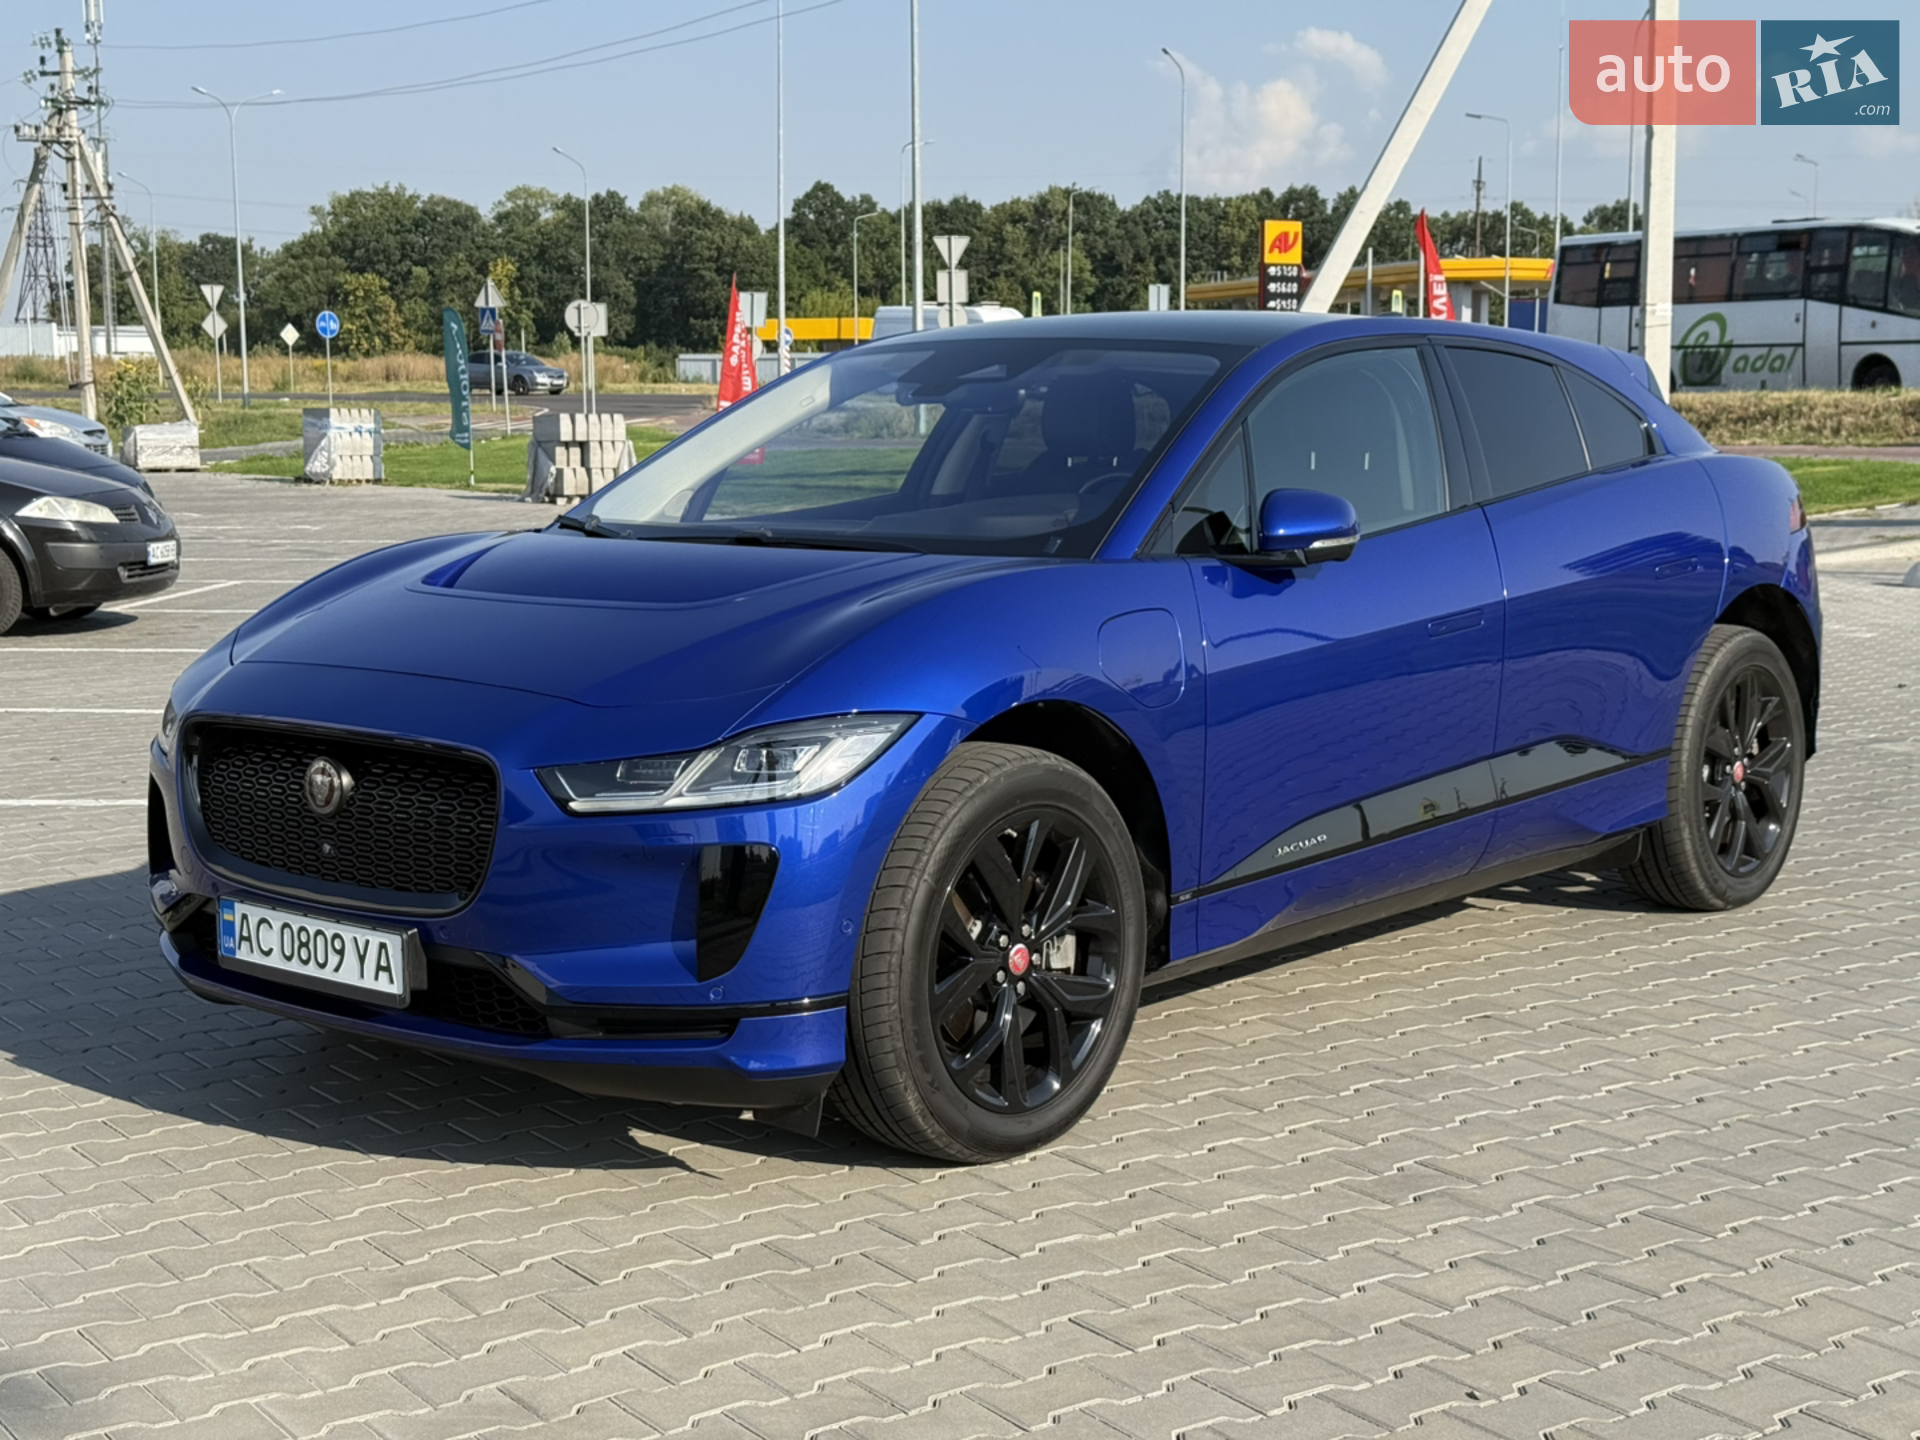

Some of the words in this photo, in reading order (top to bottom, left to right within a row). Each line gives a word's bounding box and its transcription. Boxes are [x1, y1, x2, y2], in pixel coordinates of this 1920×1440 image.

[1273, 834, 1327, 858] JAGUAR
[224, 935, 235, 949] UA
[237, 912, 274, 957] AC
[280, 922, 346, 973] 0809
[353, 936, 394, 984] YA
